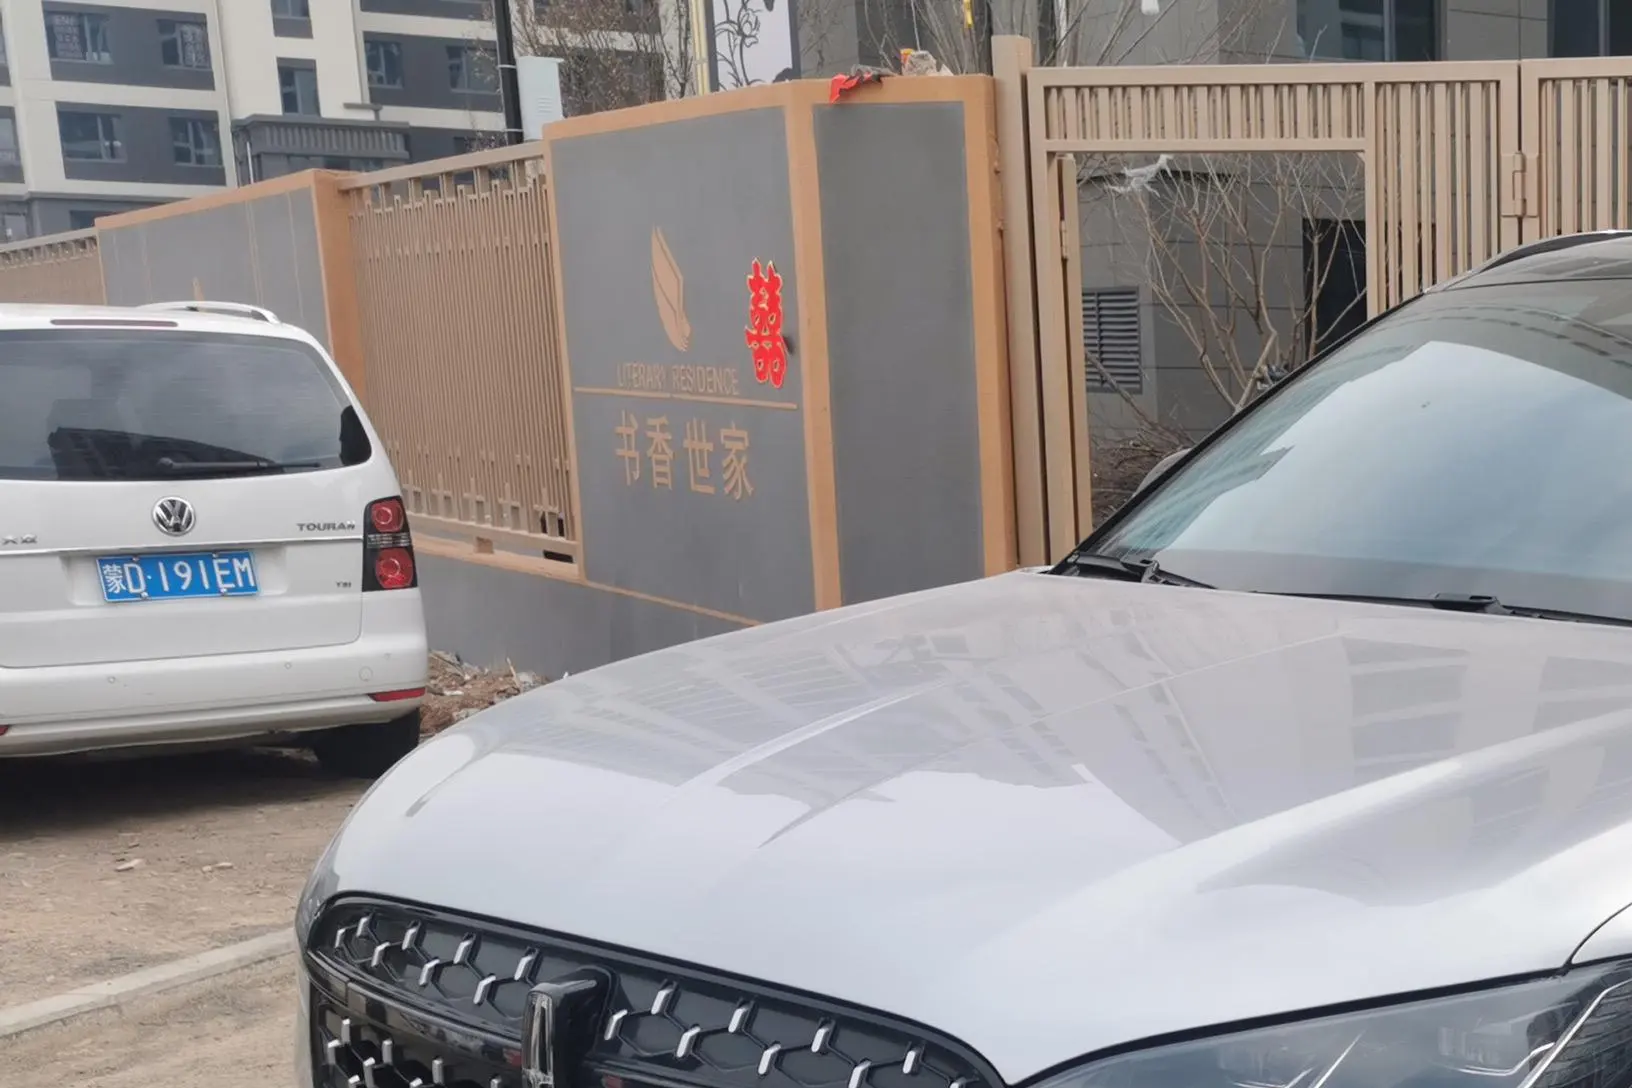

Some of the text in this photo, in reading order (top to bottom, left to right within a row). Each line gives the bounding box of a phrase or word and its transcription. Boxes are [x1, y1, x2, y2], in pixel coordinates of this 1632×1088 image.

[672, 365, 740, 396] RESIDENCE
[614, 409, 754, 500] 书香世家
[296, 521, 356, 532] TOURAN
